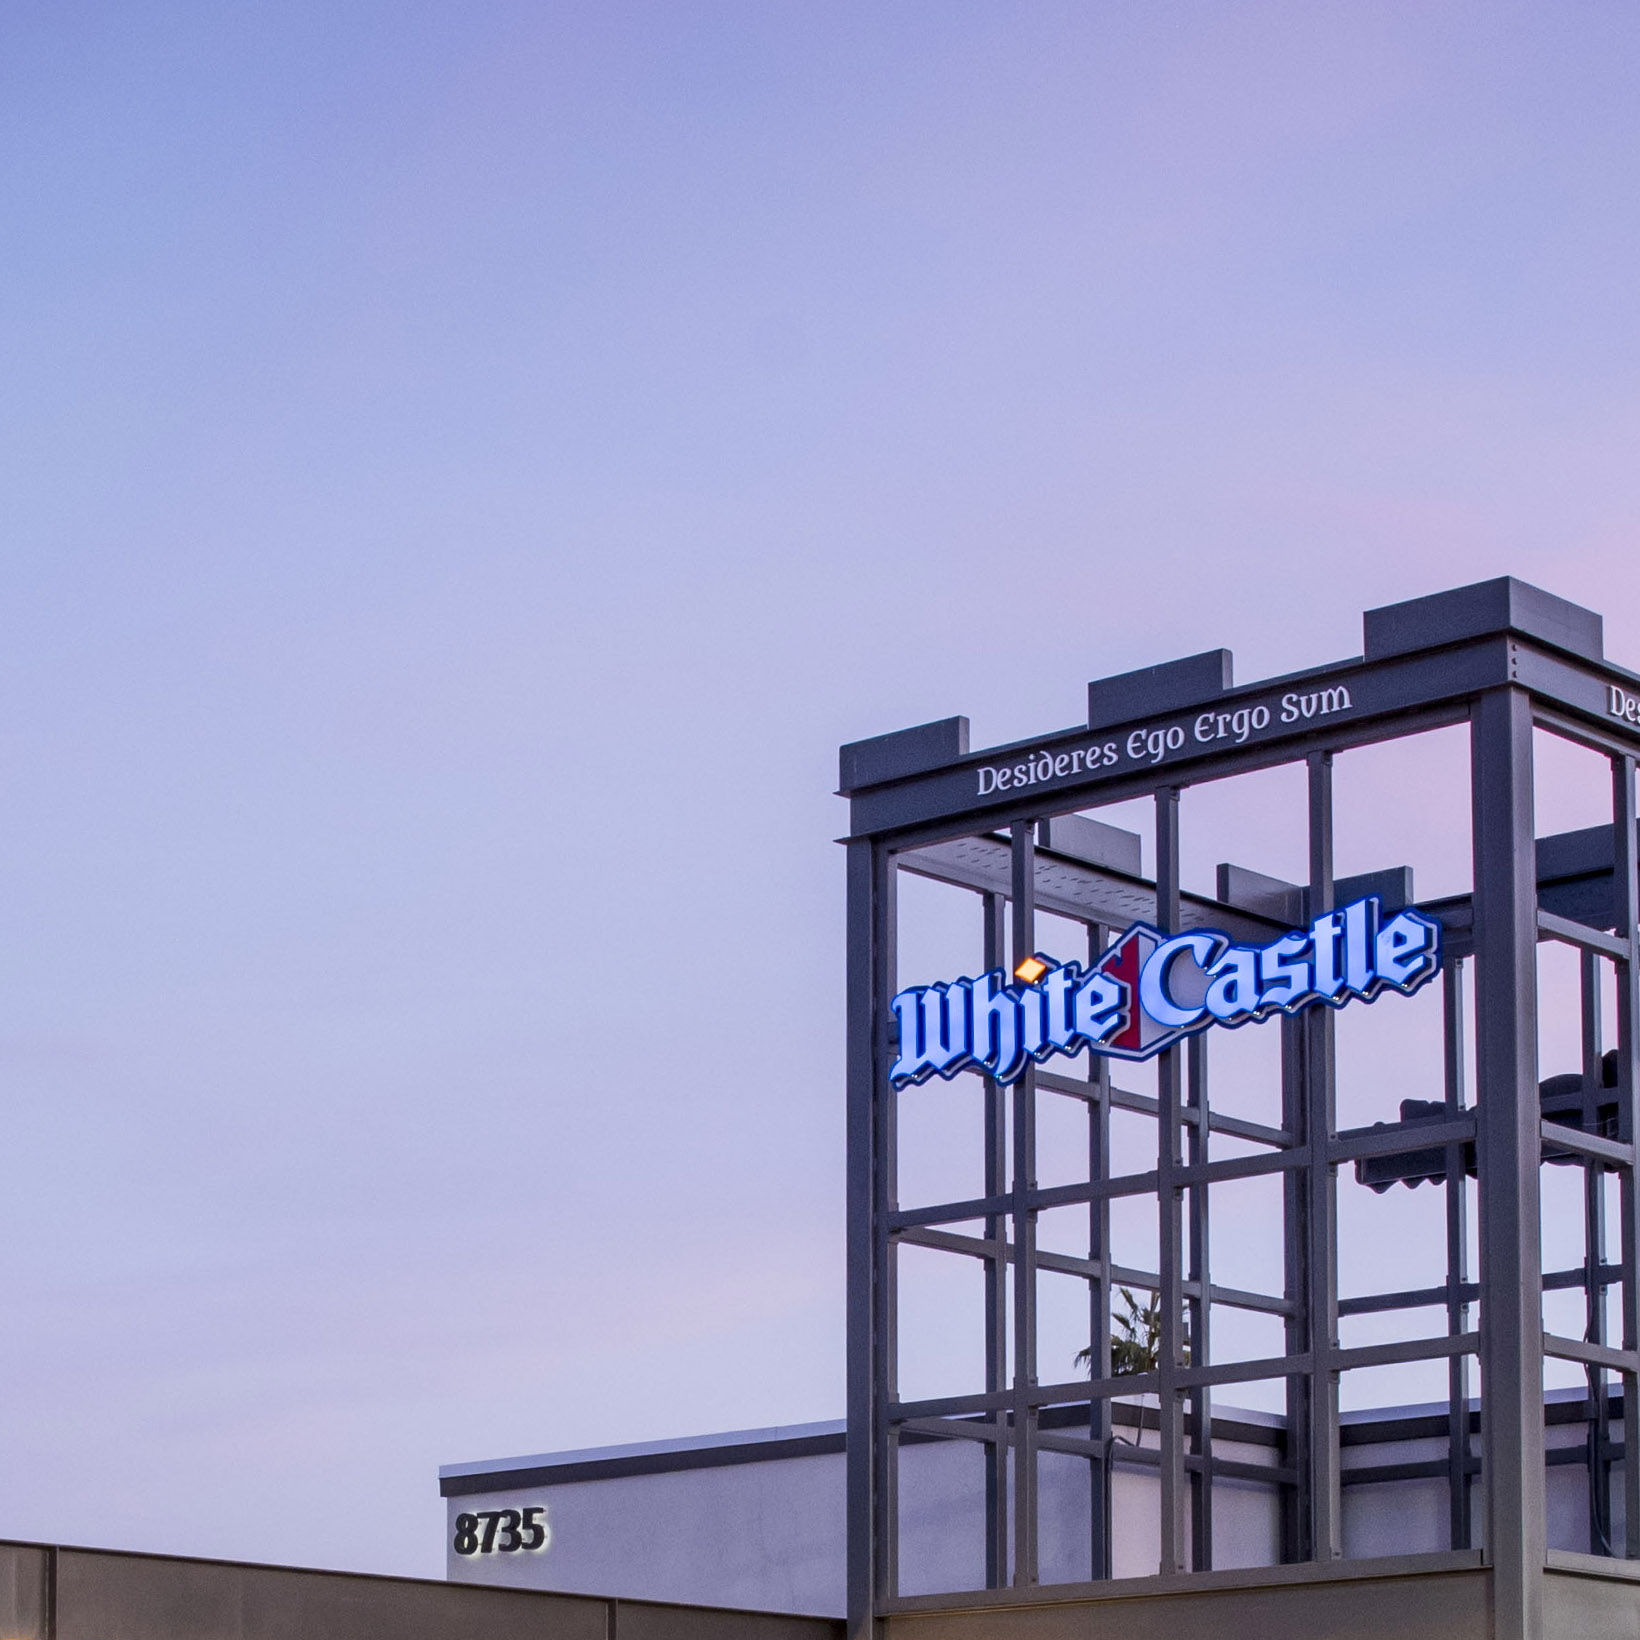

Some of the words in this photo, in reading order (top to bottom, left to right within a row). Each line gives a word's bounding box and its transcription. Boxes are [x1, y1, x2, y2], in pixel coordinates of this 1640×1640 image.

[976, 742, 1119, 796] Desideres
[1126, 726, 1186, 764] Ego
[1194, 705, 1271, 743] Ergo
[889, 957, 1122, 1083] White
[1138, 895, 1435, 1028] Castle
[453, 1506, 546, 1555] 8735
